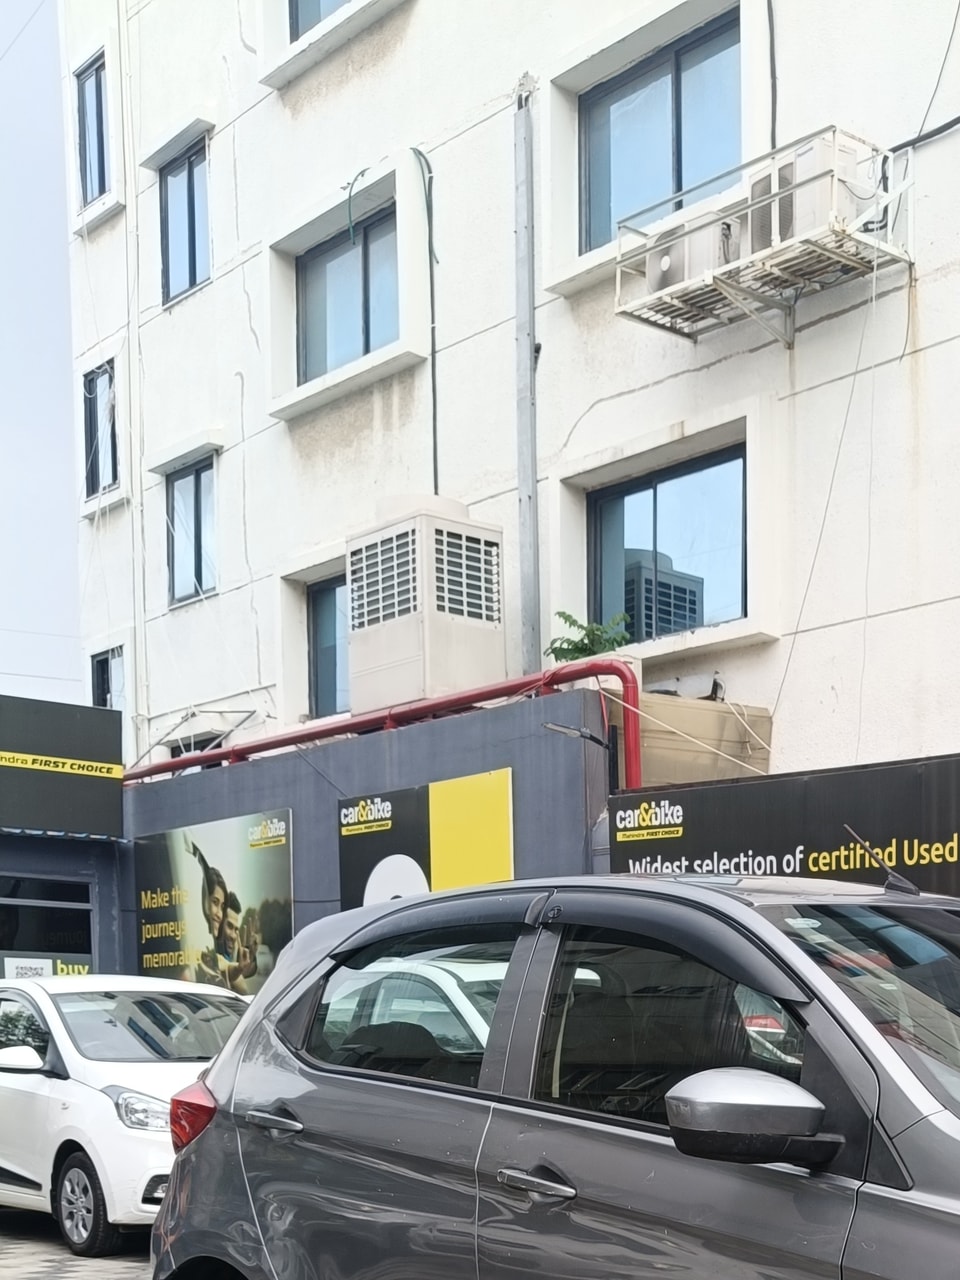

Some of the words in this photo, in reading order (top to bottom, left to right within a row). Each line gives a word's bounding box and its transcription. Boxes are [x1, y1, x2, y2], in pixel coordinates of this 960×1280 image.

[31, 758, 68, 769] FIRST
[70, 762, 114, 775] CHOICE
[341, 797, 392, 825] car&bike
[616, 800, 683, 829] car&bike
[628, 855, 689, 874] Widest
[693, 849, 777, 875] selection
[782, 845, 804, 874] of
[808, 838, 896, 872] certified
[903, 833, 958, 866] Used
[141, 887, 169, 909] Make
[142, 920, 187, 944] journeys
[56, 960, 89, 975] buy
